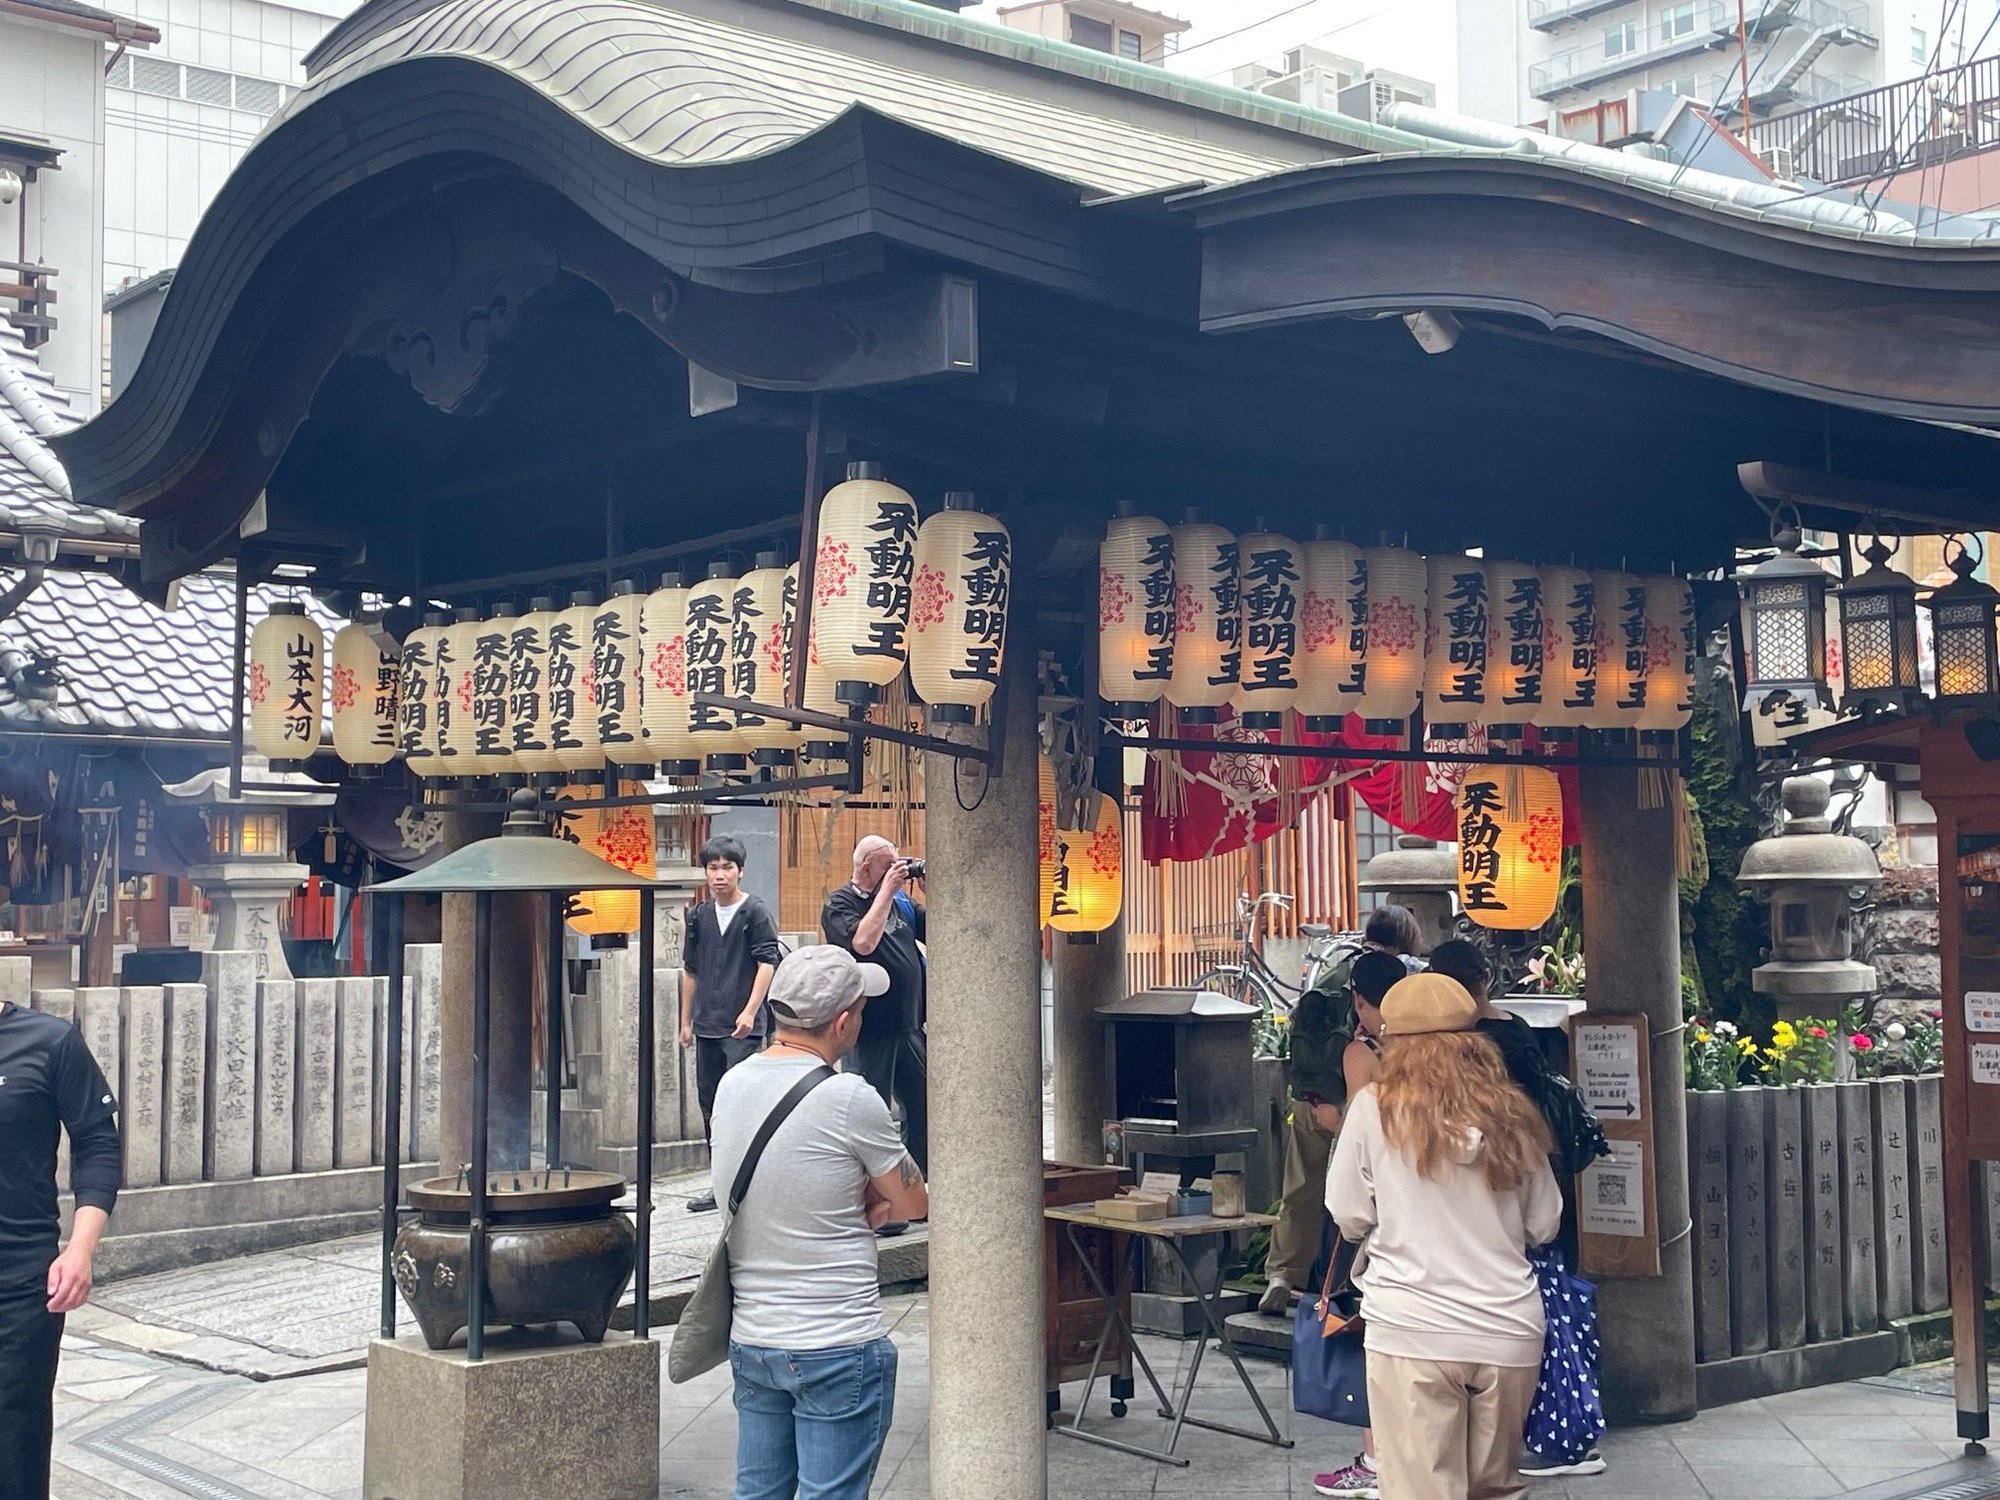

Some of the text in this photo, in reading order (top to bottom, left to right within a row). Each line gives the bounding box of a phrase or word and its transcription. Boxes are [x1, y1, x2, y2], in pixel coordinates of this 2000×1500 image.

[853, 502, 917, 661] 不動明王
[950, 531, 1011, 687] 不動明王
[1133, 533, 1175, 681] 不動明王
[1208, 541, 1242, 687] 不動明王
[1241, 549, 1299, 692] 不動明王
[1439, 571, 1489, 704] 不動明王
[1503, 577, 1543, 705] 不動明王
[1564, 583, 1597, 708] 不動明王
[284, 633, 314, 742] 山本大河
[402, 641, 434, 757] 不動明王
[473, 633, 513, 756] 不動明王
[509, 627, 549, 751] 不動明王
[549, 622, 584, 750] 不動明王
[592, 611, 634, 744] 不動明王
[685, 594, 733, 733] 不動明王
[1616, 586, 1647, 709] 不動明王
[1461, 782, 1508, 911] 不動明王
